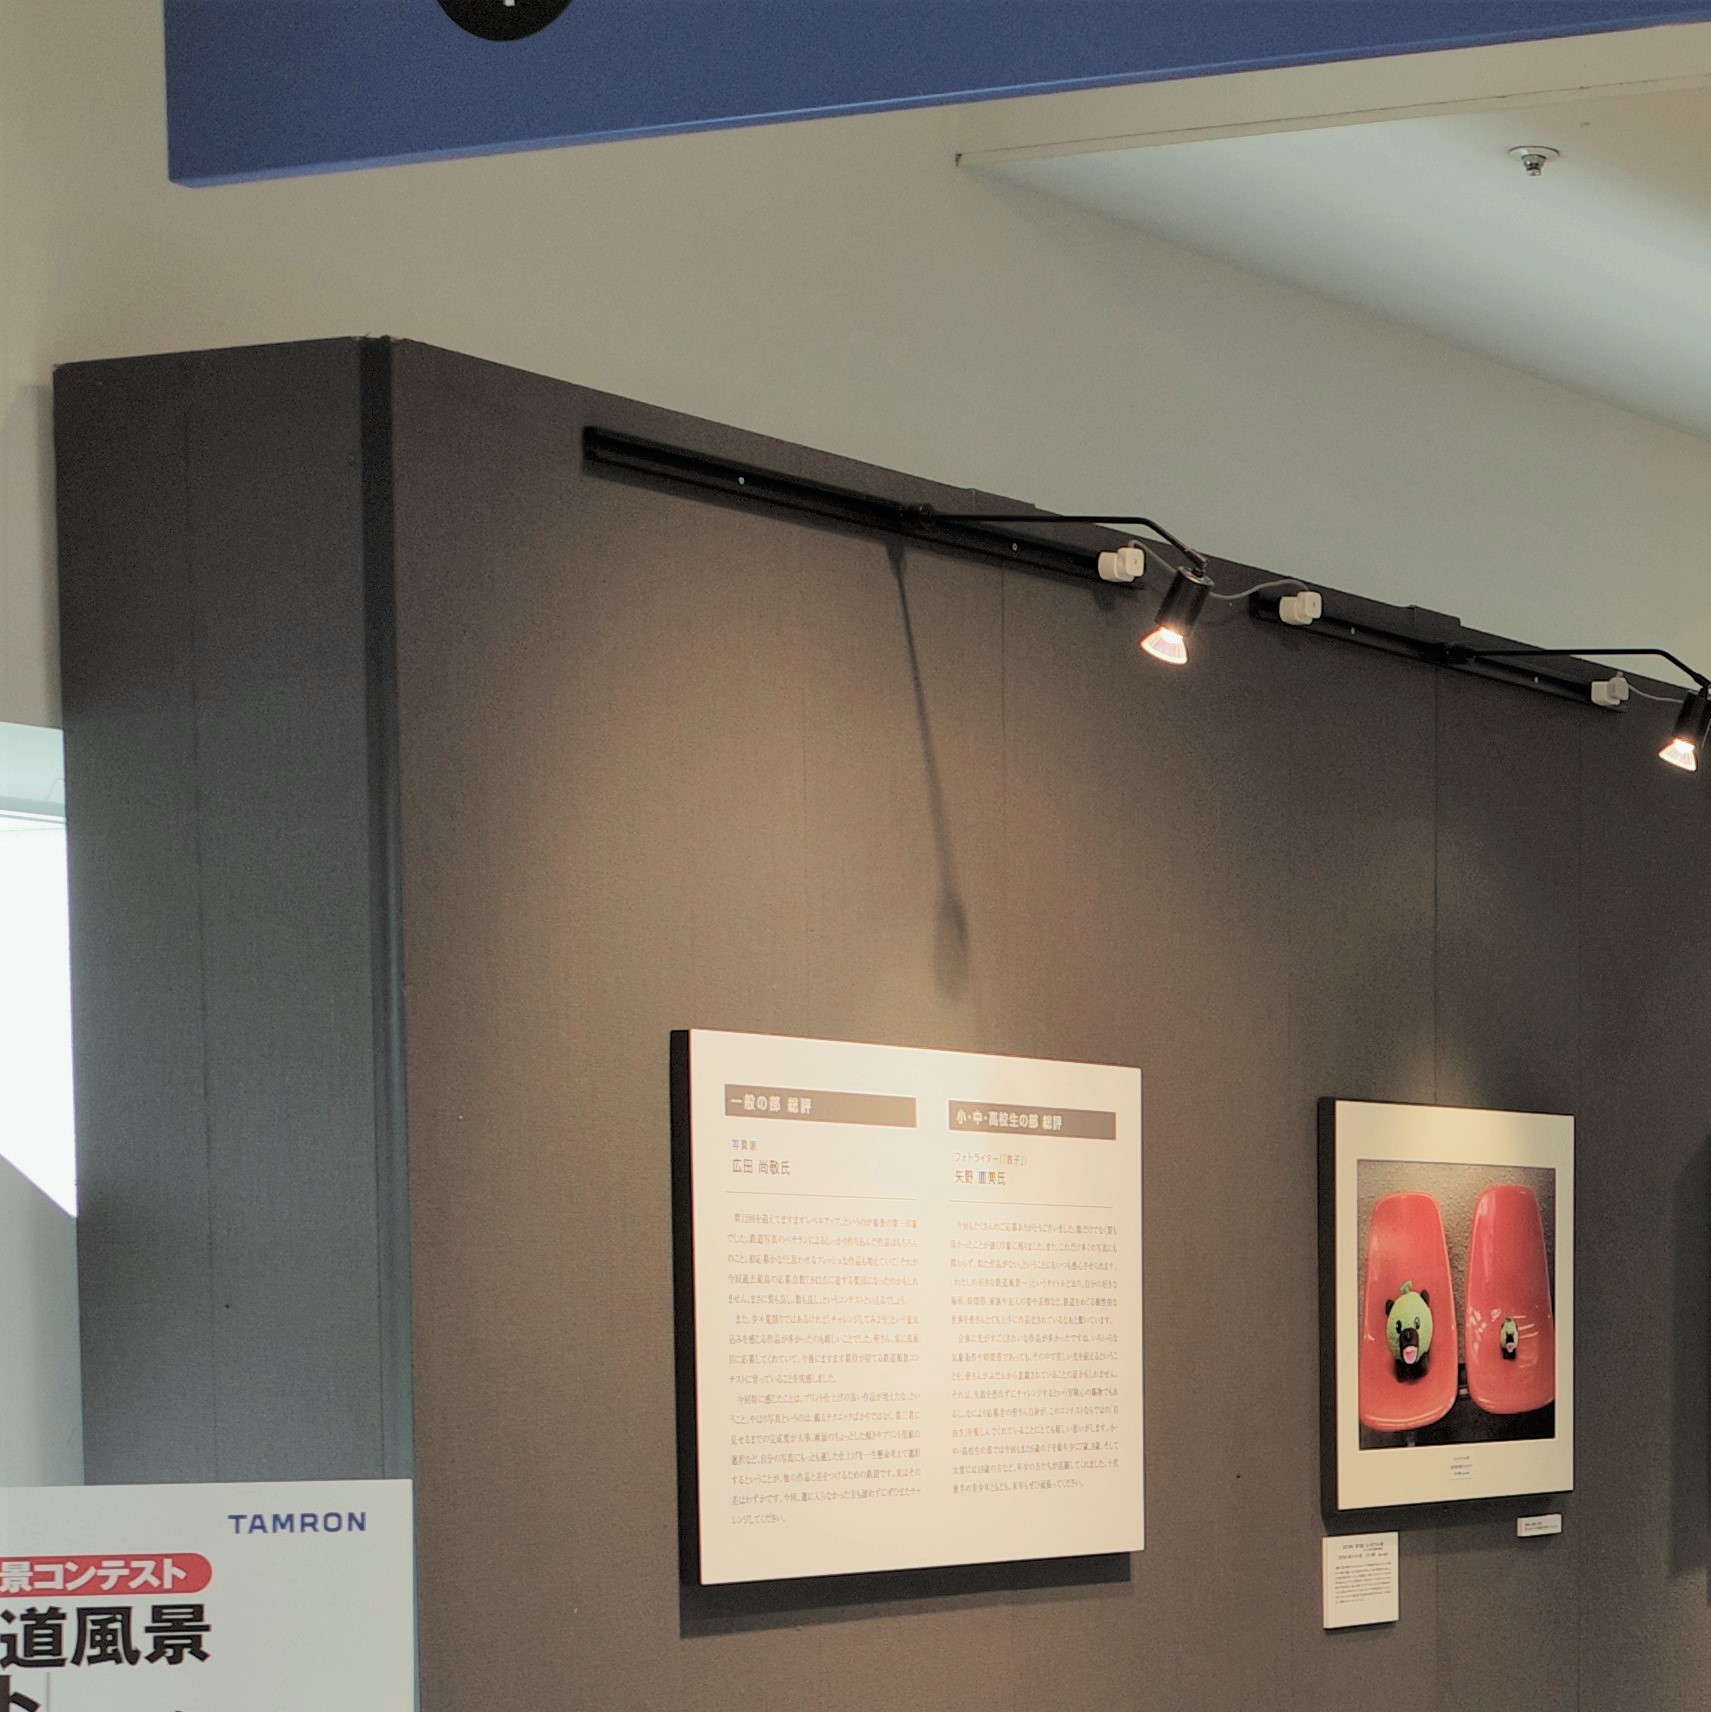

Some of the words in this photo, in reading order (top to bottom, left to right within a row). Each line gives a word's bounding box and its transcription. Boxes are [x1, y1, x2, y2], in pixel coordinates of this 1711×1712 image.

[731, 1093, 781, 1113] 一般の部
[787, 1096, 812, 1115] 総評
[956, 1108, 1039, 1130] 小・中・高校生の部
[1043, 1115, 1064, 1131] 総評
[732, 1159, 754, 1175] 広田
[955, 1170, 974, 1185] 矢野
[228, 1512, 365, 1534] TAMRON
[0, 1604, 212, 1667] 道風景
